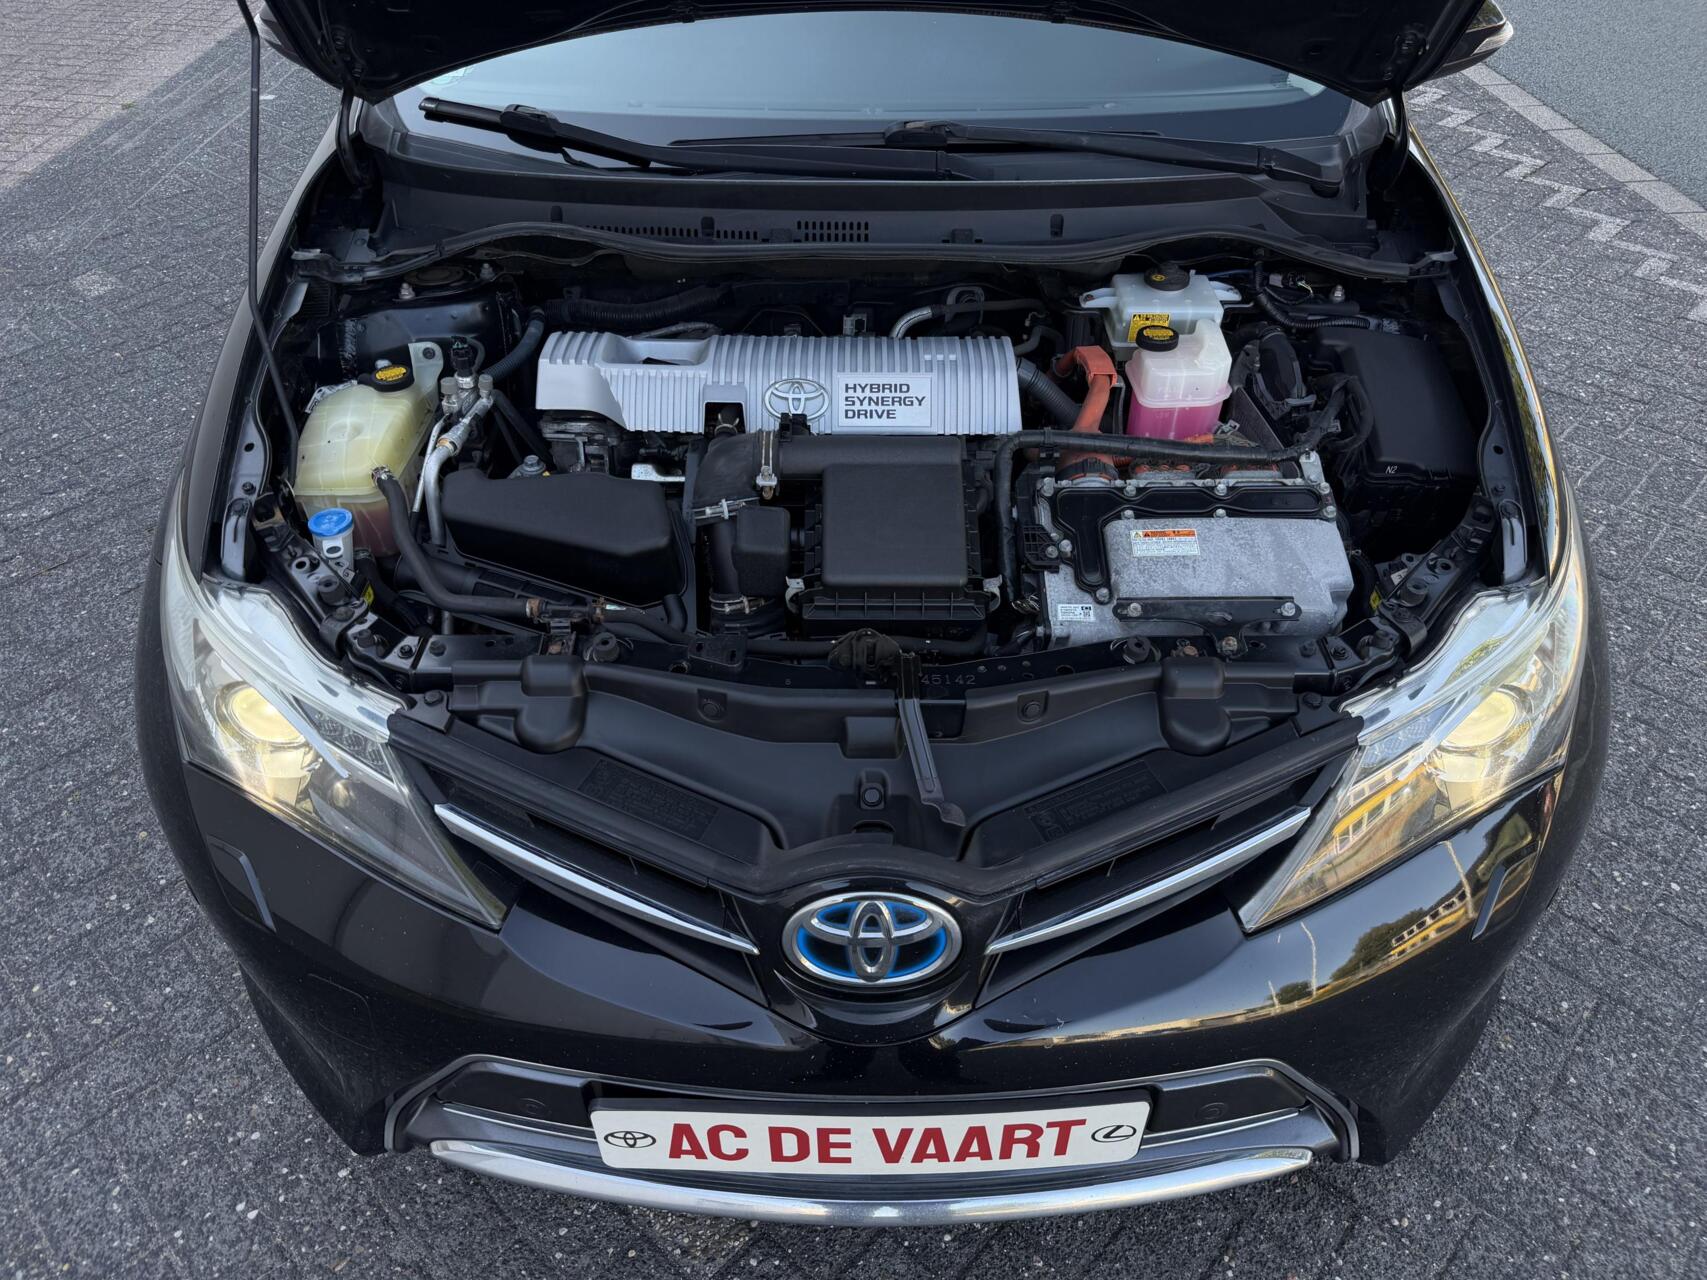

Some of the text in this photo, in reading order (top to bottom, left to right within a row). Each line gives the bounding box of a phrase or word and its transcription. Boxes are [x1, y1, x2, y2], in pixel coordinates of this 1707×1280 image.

[844, 383, 911, 394] HYBRID
[844, 396, 926, 407] SYNERGY
[844, 409, 897, 420] DRIVE
[668, 1118, 1087, 1164] AC DE VAART
